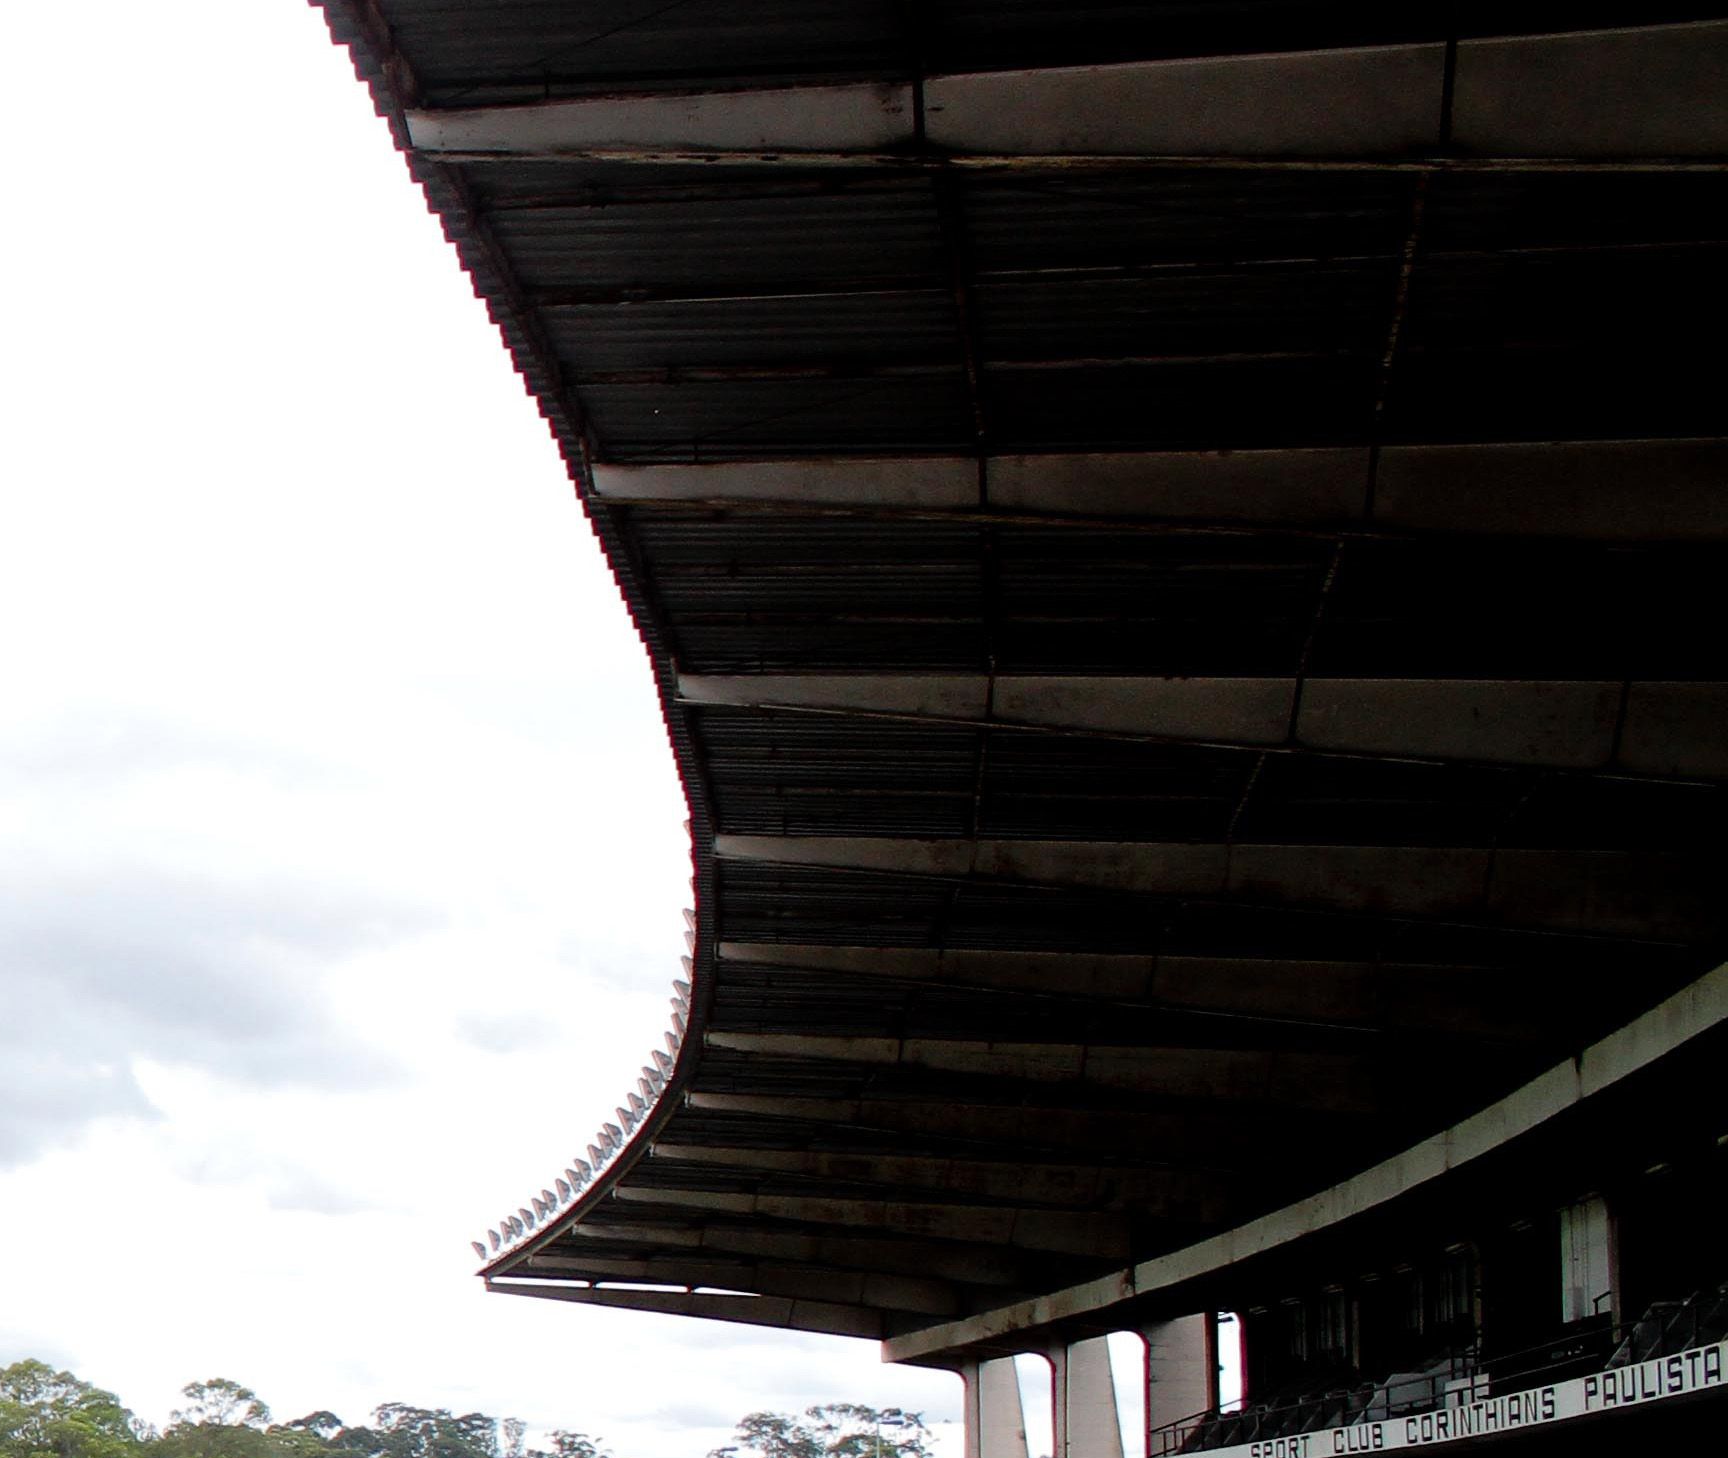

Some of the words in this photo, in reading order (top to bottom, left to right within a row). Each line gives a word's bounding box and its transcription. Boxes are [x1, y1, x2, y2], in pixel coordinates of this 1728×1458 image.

[1333, 1423, 1383, 1454] CLUB
[1405, 1387, 1556, 1444] CORINTHIANS
[1584, 1345, 1721, 1411] PAULISTA
